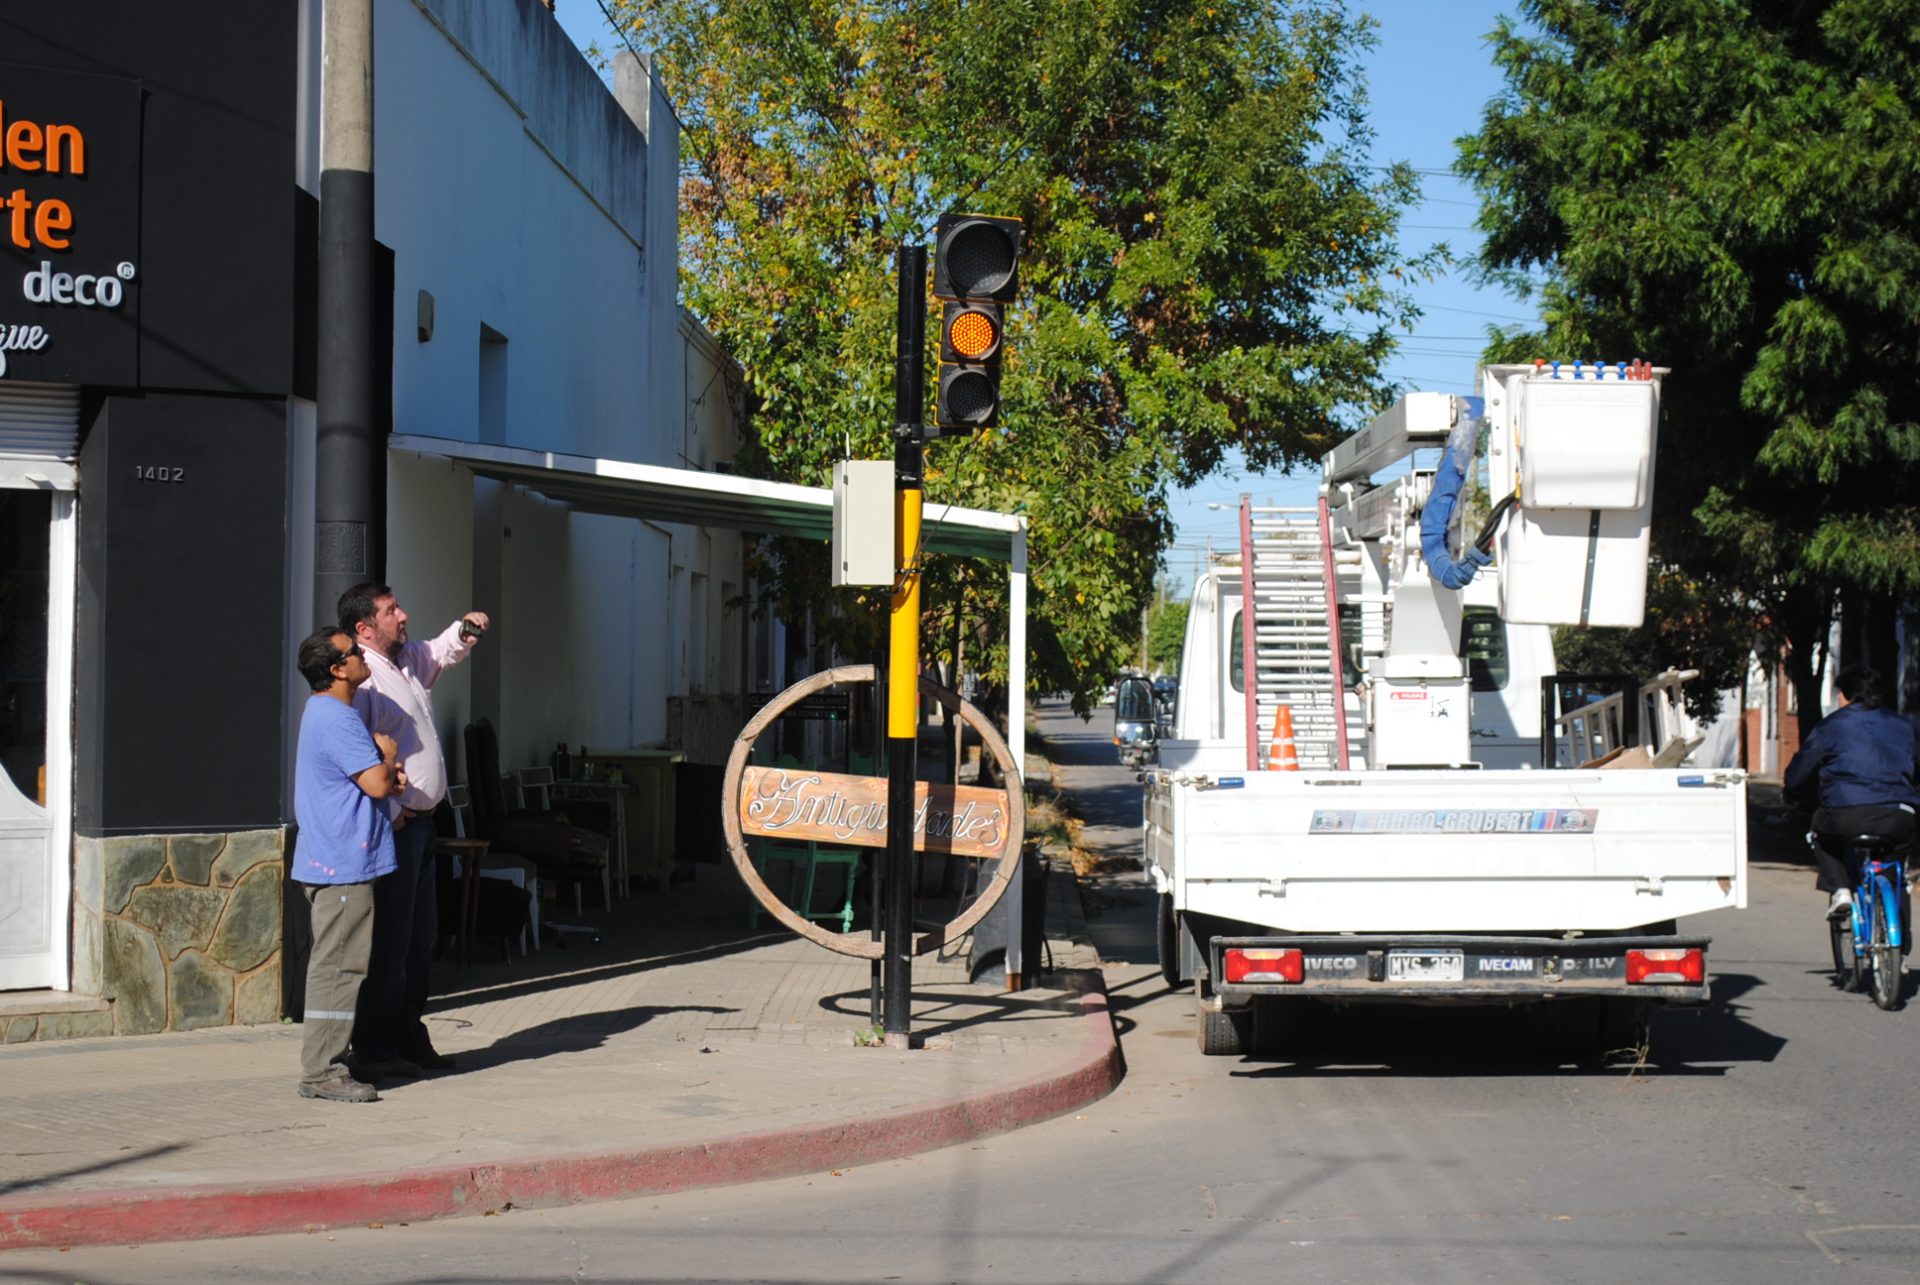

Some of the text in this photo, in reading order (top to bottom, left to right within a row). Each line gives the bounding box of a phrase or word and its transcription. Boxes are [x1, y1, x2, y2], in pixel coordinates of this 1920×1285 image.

[0, 99, 84, 174] en
[0, 189, 72, 249] te
[136, 465, 184, 481] 1402
[1376, 810, 1533, 832] HIDRO-GRUBERT
[1304, 957, 1358, 970] IVECO
[1479, 958, 1533, 971] IVECAM
[1563, 957, 1616, 971] DILY
